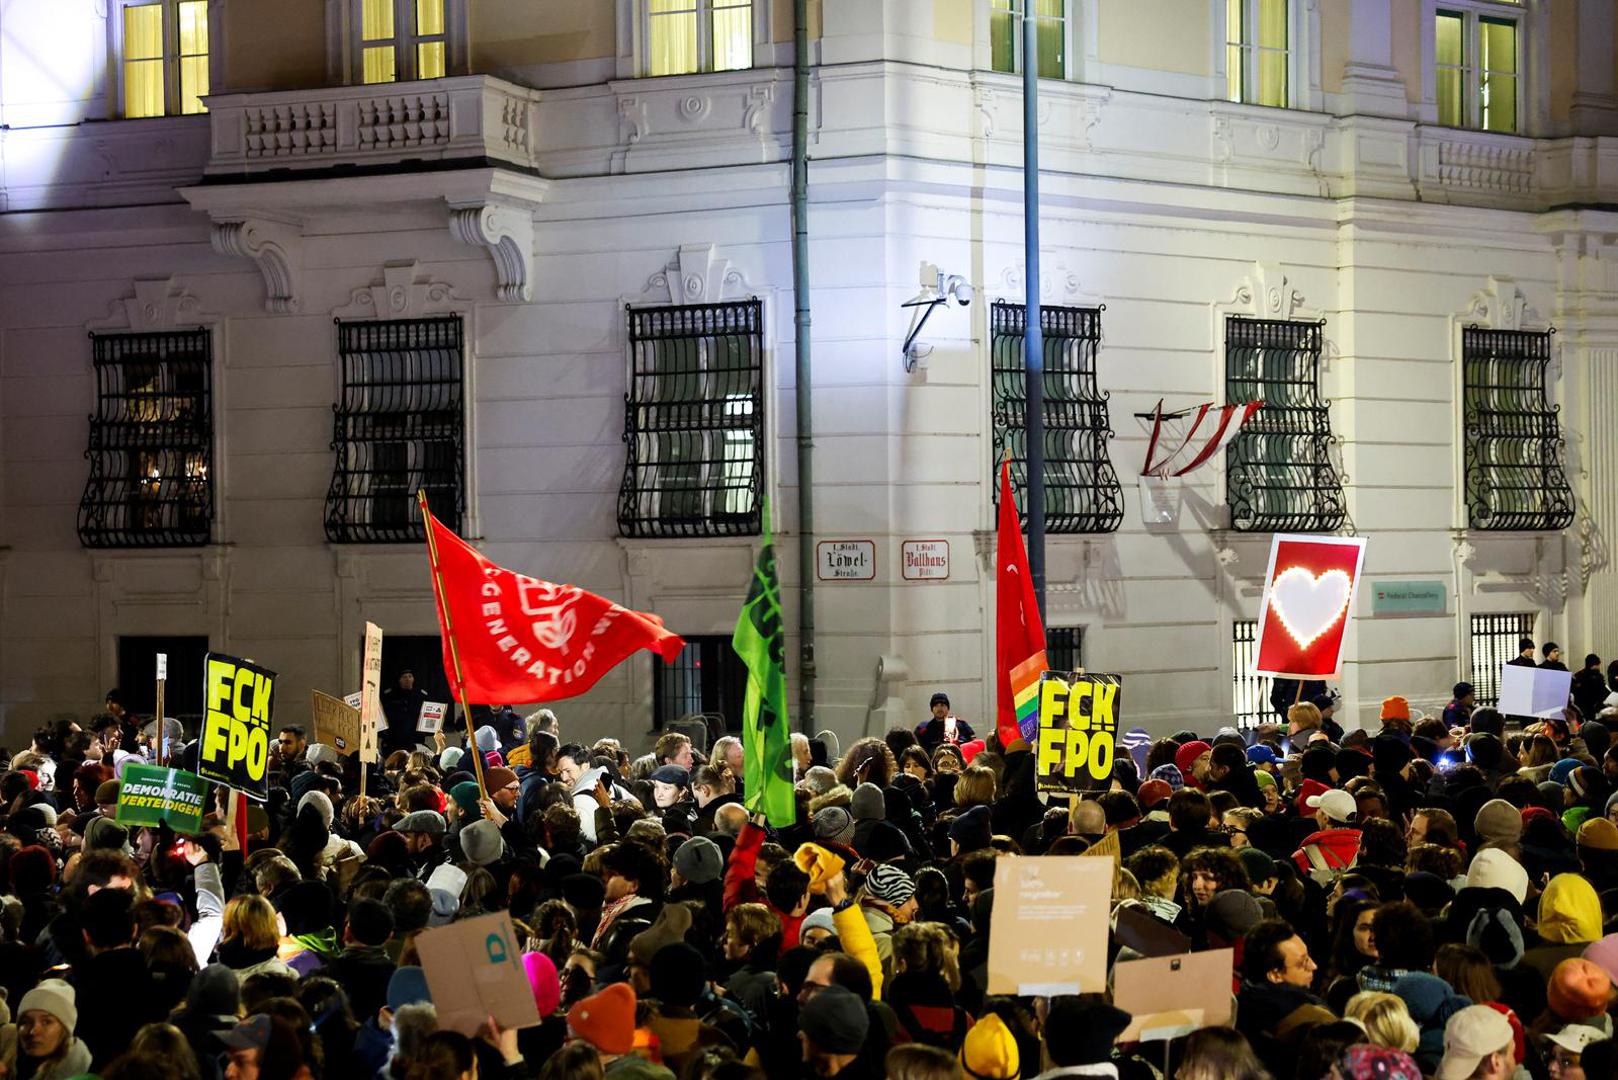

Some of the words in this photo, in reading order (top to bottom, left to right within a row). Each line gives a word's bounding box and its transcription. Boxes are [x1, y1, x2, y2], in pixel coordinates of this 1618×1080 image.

[826, 551, 868, 568] Löwel-
[481, 582, 596, 685] GENERATION
[208, 659, 272, 724] FCK
[1040, 679, 1117, 732] FCK
[202, 710, 270, 782] FPÖ
[1038, 724, 1115, 780] FPÖ
[120, 794, 202, 816] VERTEIDIGEN
[122, 783, 204, 804] DEMOKRATIE
